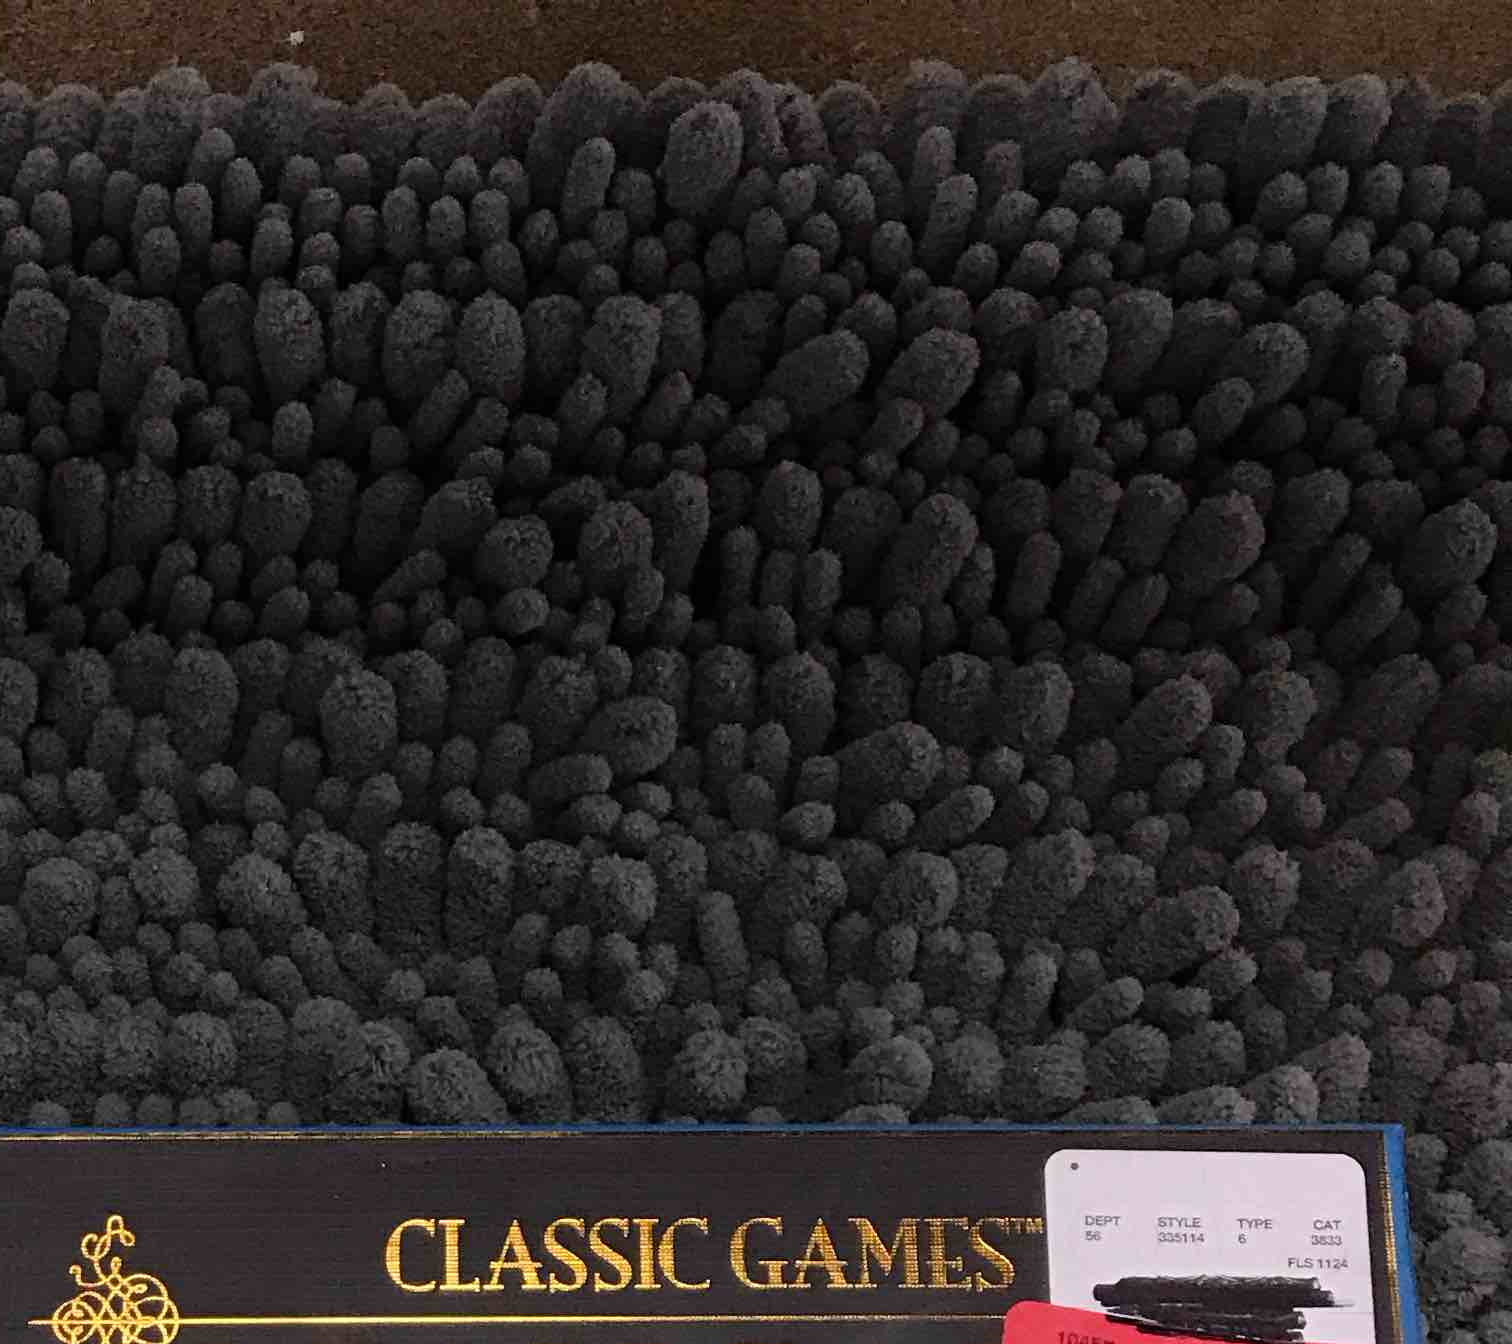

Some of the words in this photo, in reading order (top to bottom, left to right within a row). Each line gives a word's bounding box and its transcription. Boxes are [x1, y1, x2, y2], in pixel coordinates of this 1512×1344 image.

[1085, 1215, 1121, 1227] DEPT
[1157, 1217, 1202, 1229] STYLE
[1237, 1219, 1273, 1230] TYPE
[1313, 1219, 1342, 1231] CAT
[1237, 1233, 1248, 1245] 6
[384, 1217, 709, 1294] CLASSIC
[1287, 1257, 1314, 1269] FLS
[1317, 1257, 1349, 1270] 1124
